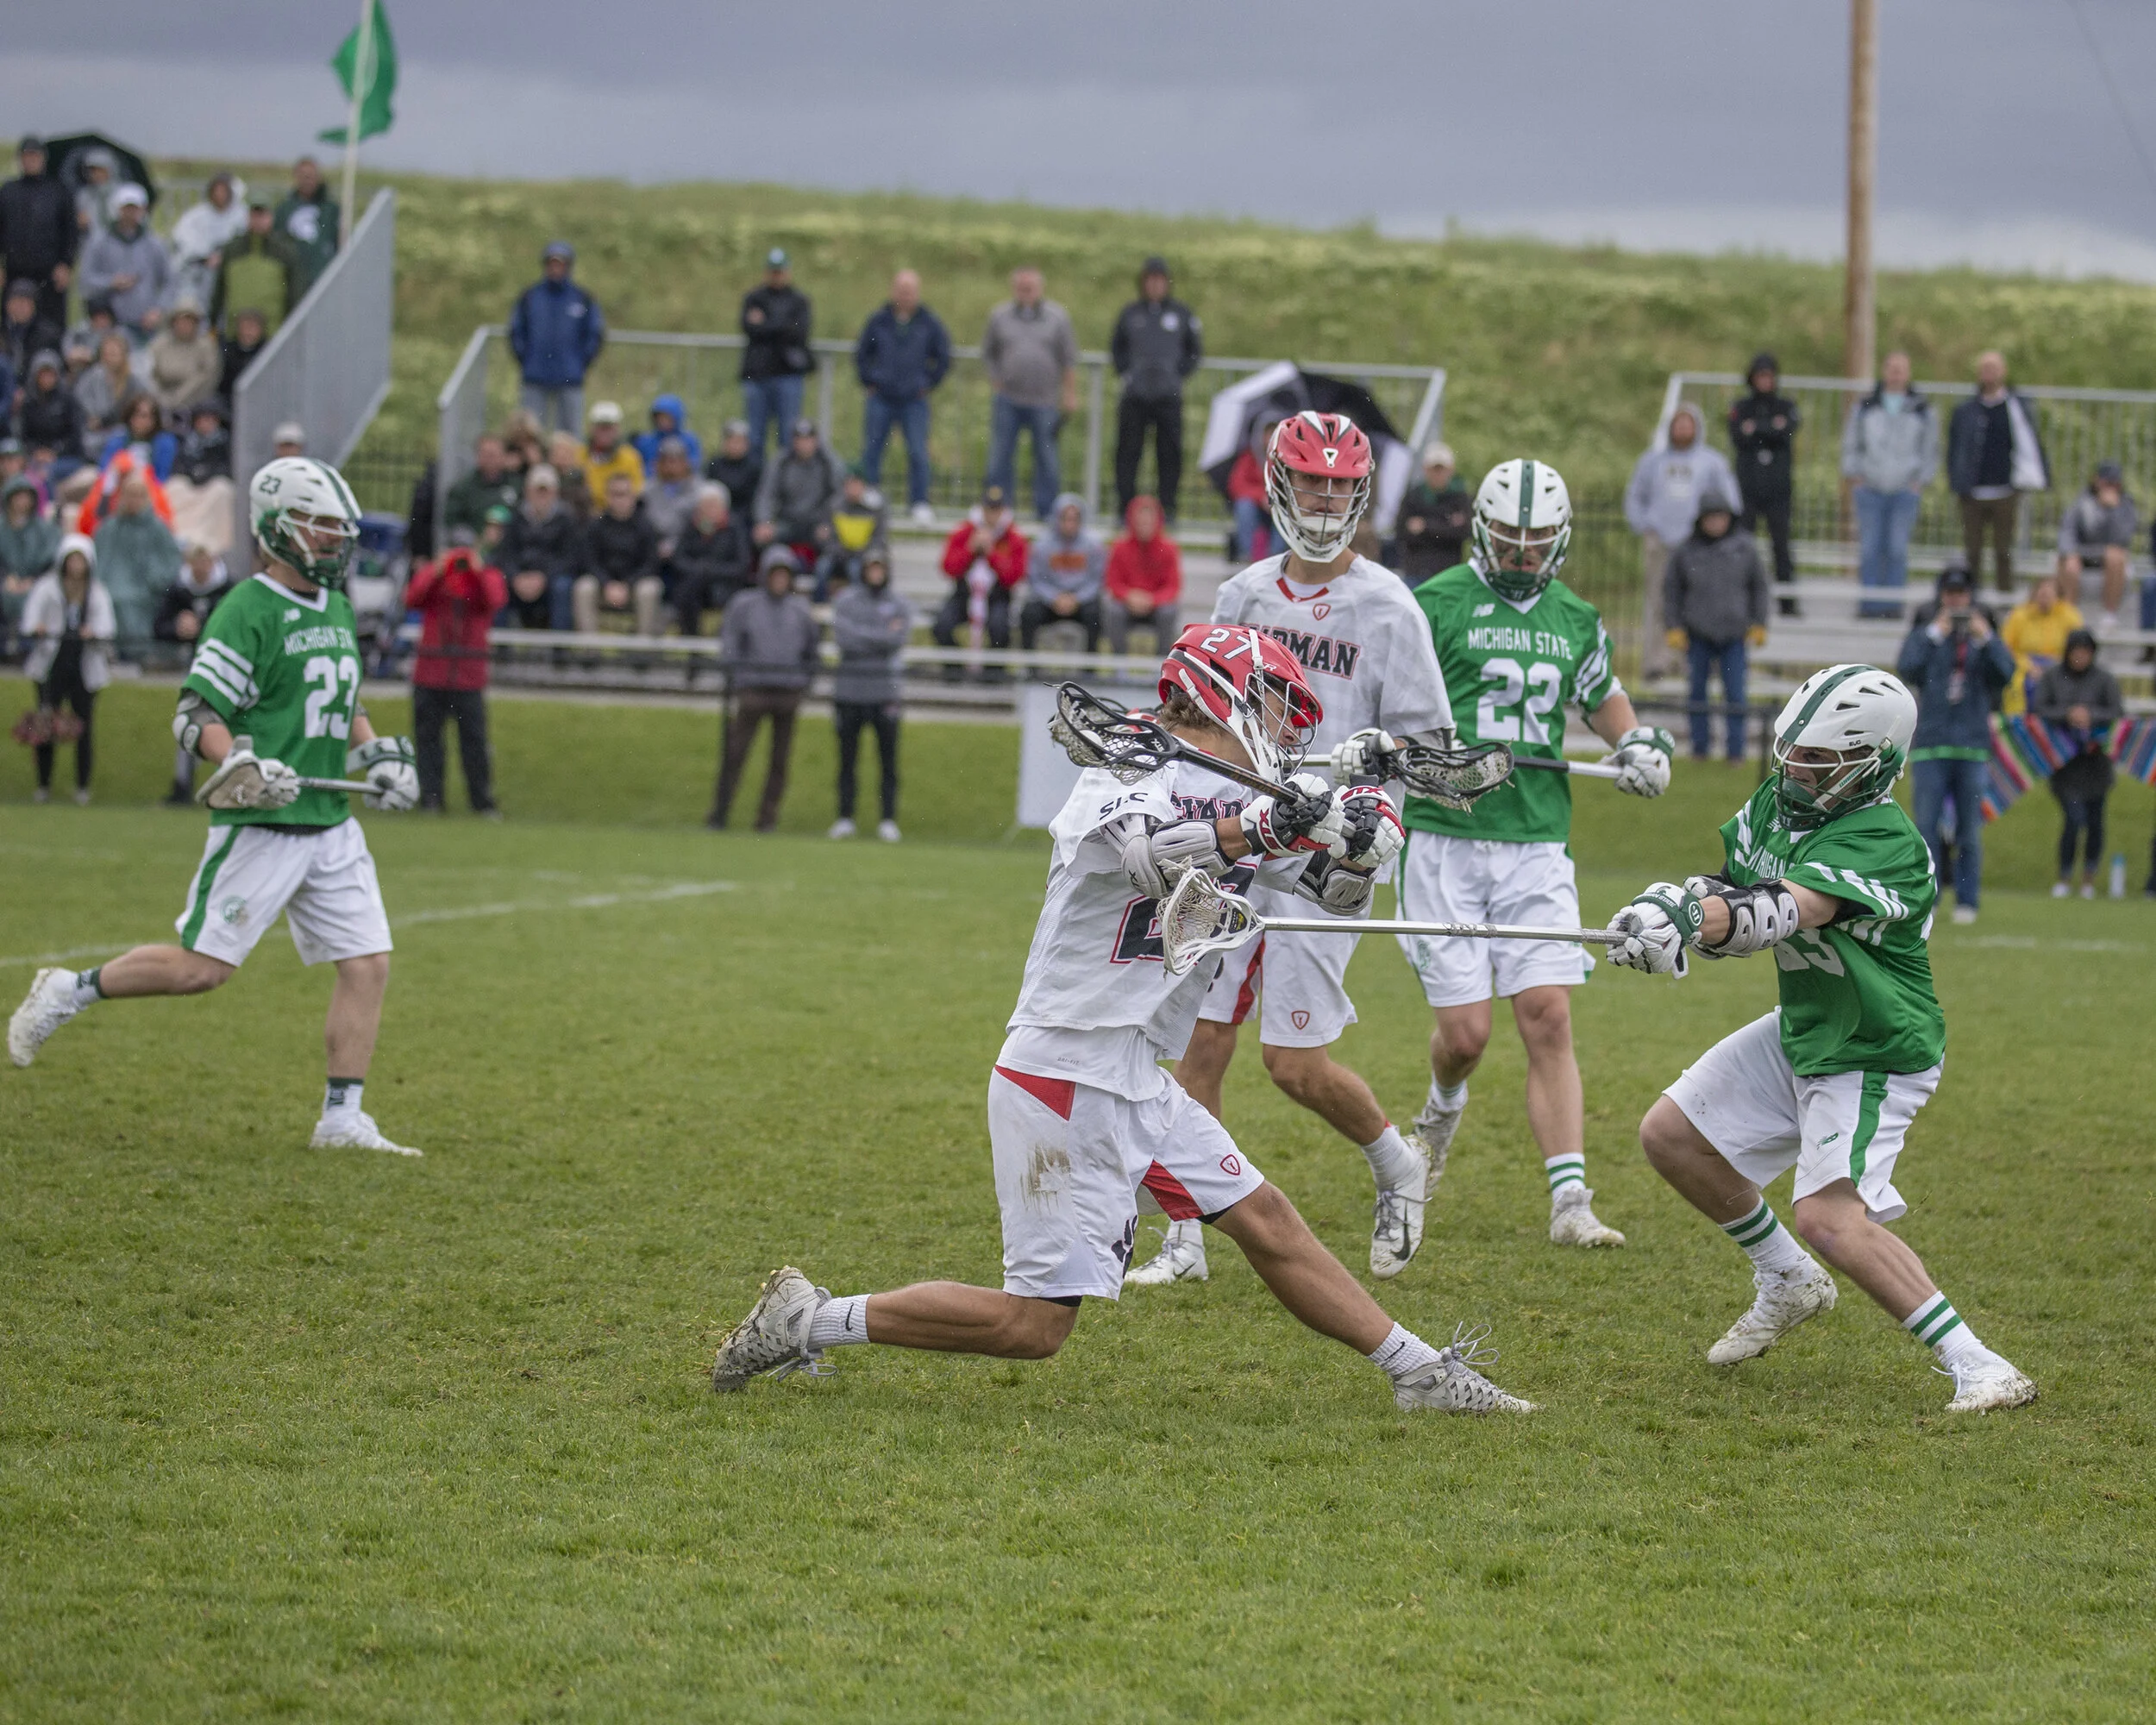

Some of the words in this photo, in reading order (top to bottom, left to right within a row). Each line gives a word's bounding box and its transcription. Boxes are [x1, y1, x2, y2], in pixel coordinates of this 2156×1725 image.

[260, 474, 282, 495] 23
[284, 625, 338, 656] MICHIGAN
[1200, 627, 1252, 661] 27
[1468, 627, 1532, 652] MICHIGAN
[1535, 630, 1574, 661] STATE
[304, 655, 359, 741] 23
[1476, 658, 1563, 745] 22
[1259, 807, 1284, 850] STX
